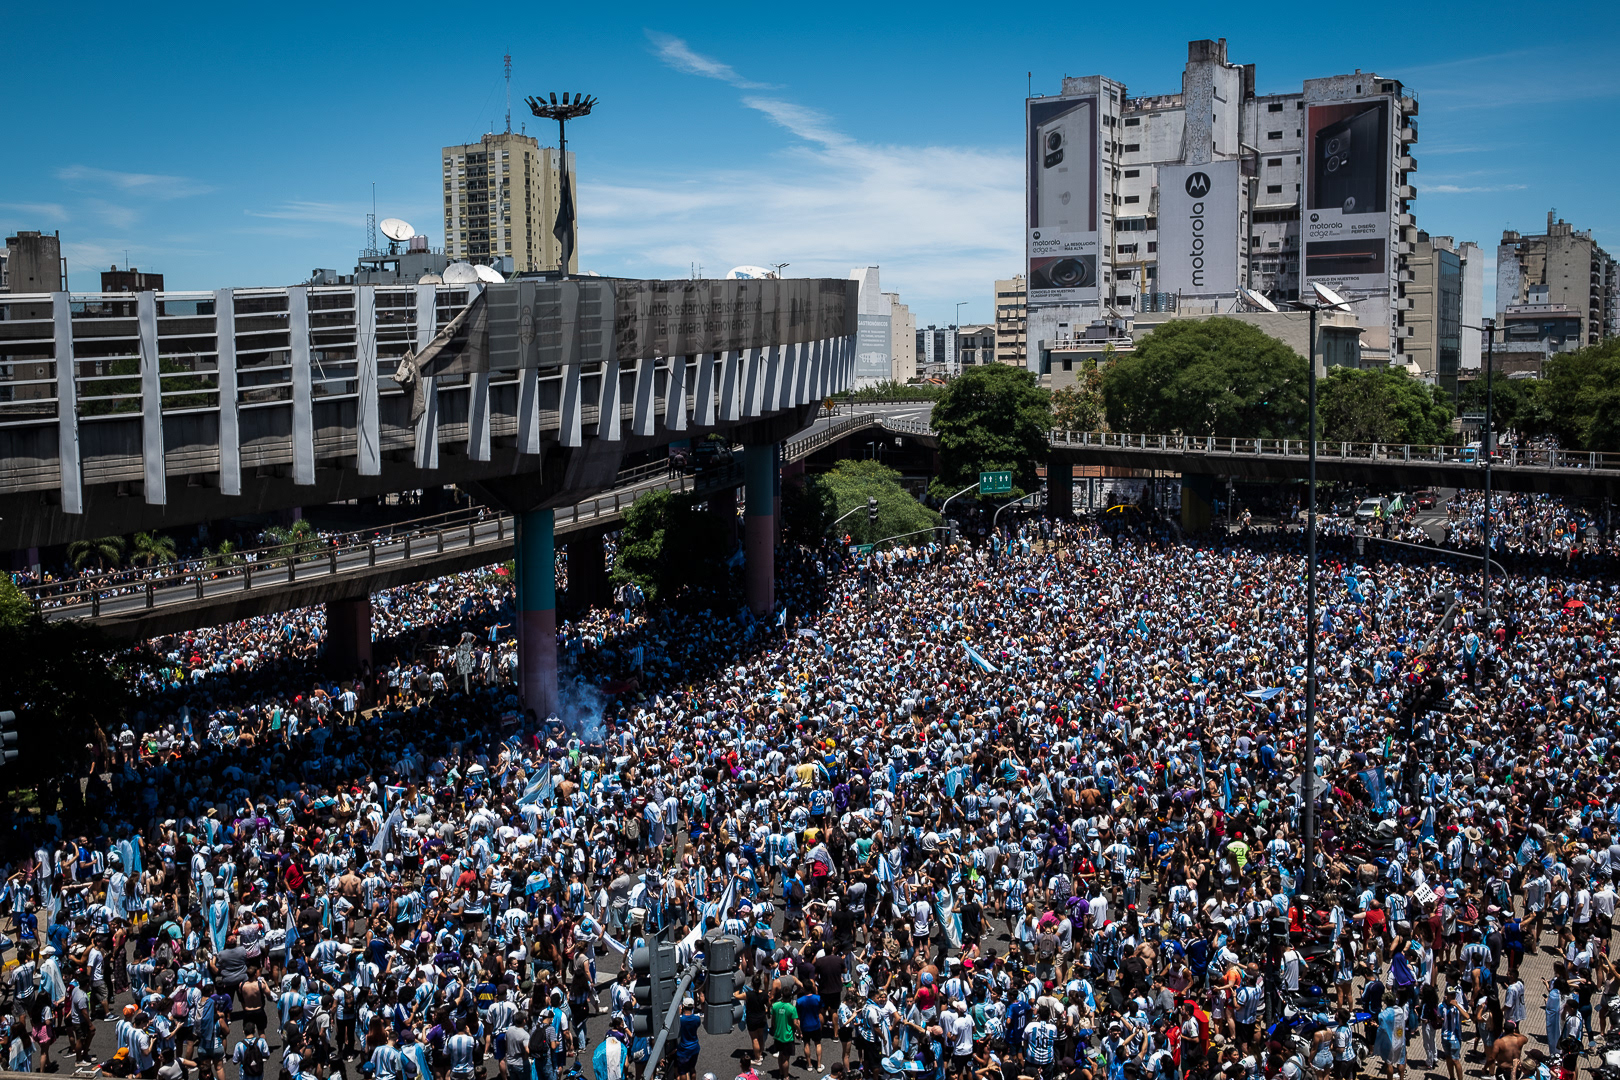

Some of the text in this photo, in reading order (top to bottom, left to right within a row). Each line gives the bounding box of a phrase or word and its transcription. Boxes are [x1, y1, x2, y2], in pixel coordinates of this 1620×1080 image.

[1309, 222, 1343, 230] motorola
[1309, 230, 1329, 239] edge
[1032, 239, 1061, 247] motorola
[1189, 202, 1204, 287] motorola
[1032, 247, 1049, 255] edge
[641, 297, 762, 317] Juntos estamos transformando
[658, 317, 752, 336] la manera de movemos.
[815, 796, 824, 806] 22
[509, 916, 520, 927] 10
[1017, 1015, 1026, 1030] 10
